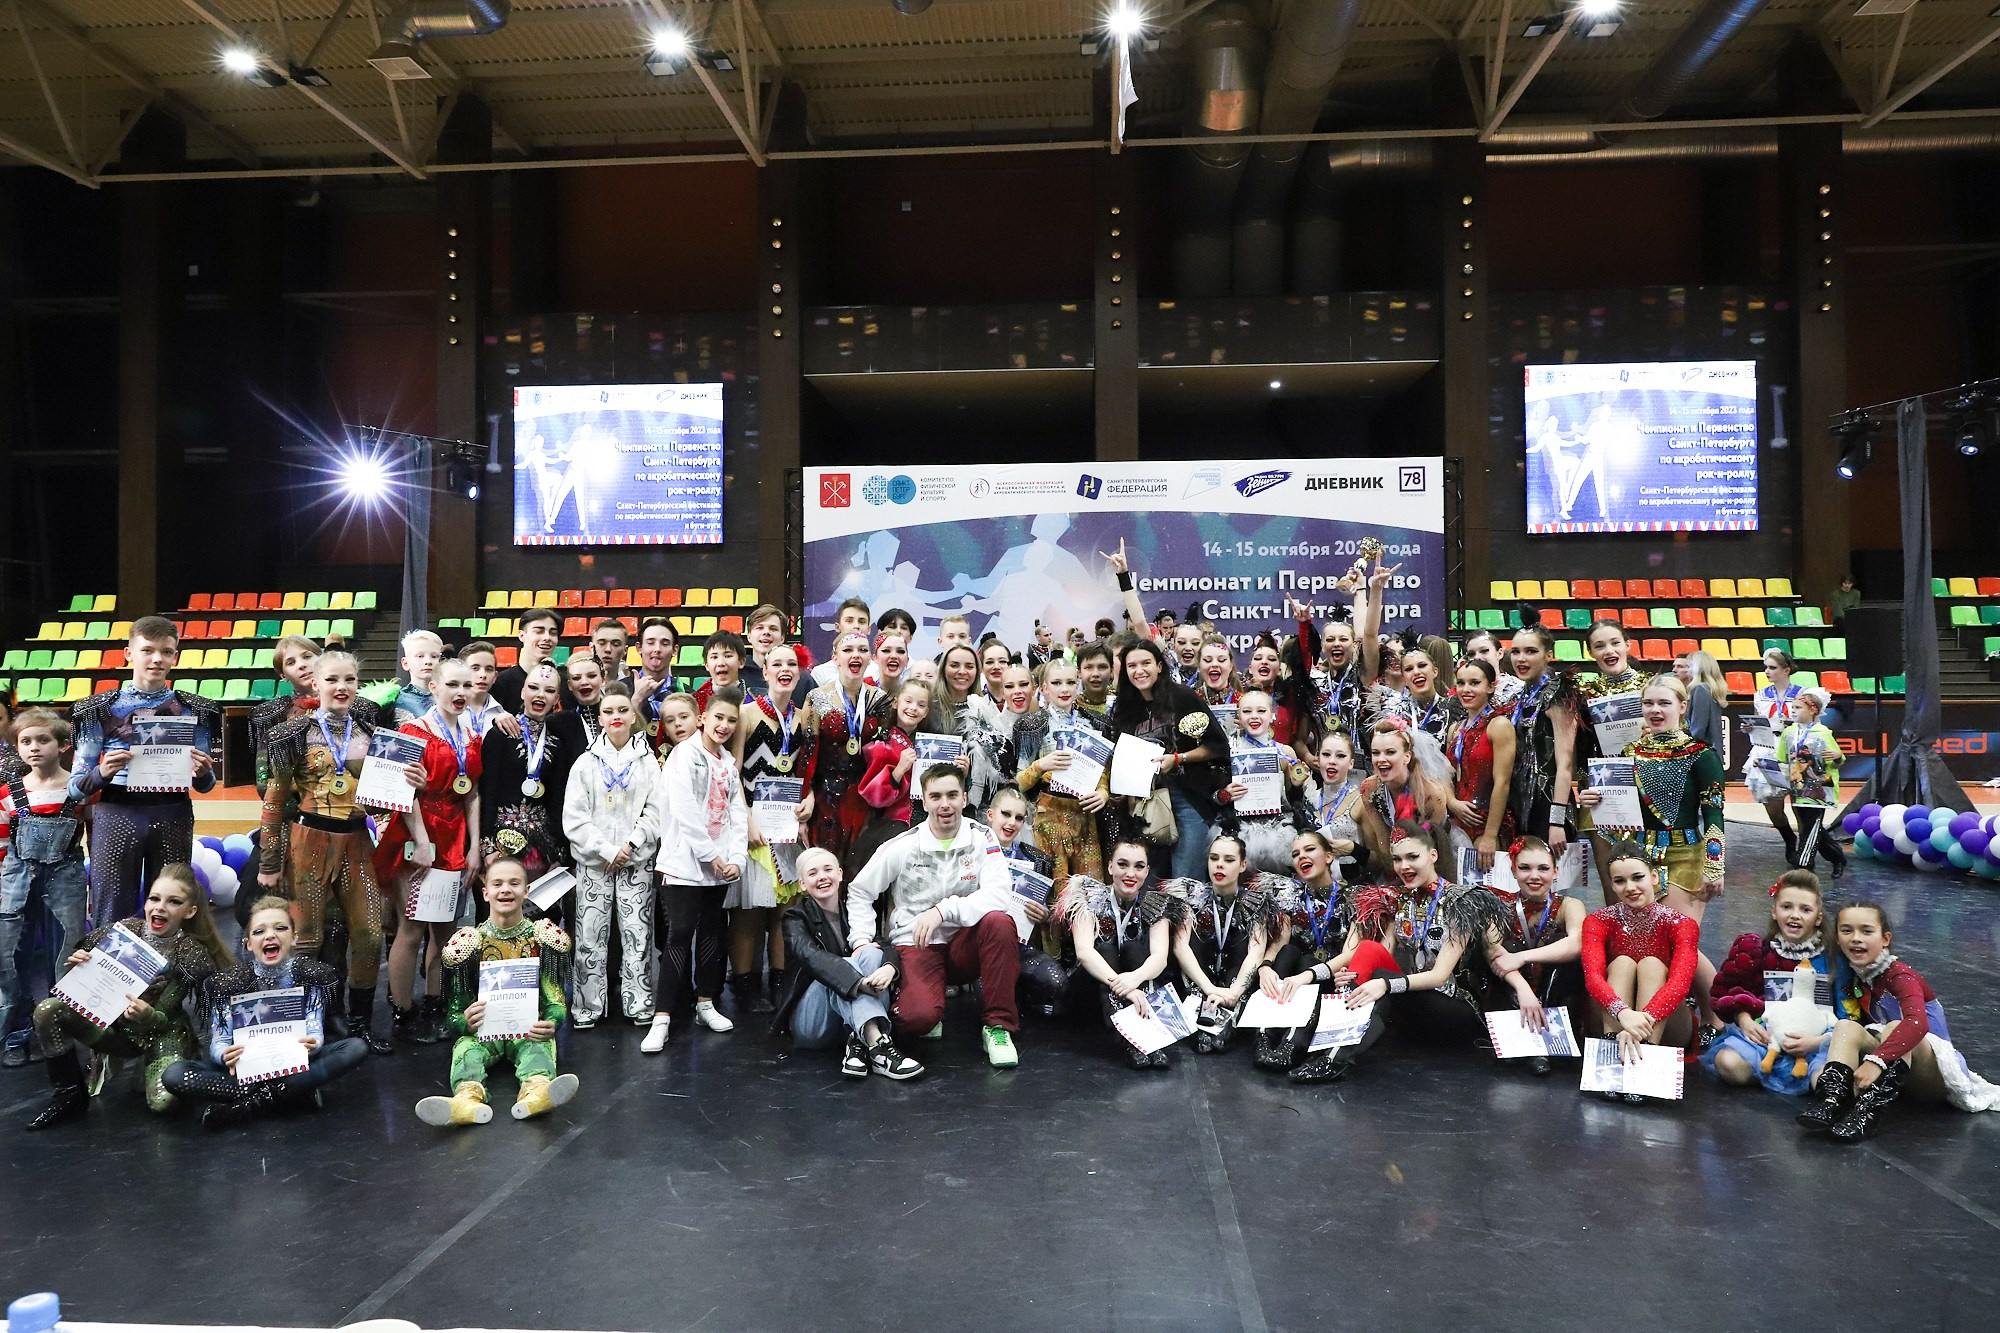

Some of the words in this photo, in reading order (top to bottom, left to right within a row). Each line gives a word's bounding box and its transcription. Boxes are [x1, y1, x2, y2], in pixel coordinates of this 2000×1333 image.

[1720, 405, 1737, 415] 2023
[1738, 407, 1754, 415] года
[690, 425, 705, 434] 2023
[1698, 421, 1755, 435] Первенство
[670, 440, 721, 453] Первенство
[1668, 436, 1755, 450] Санкт-Петербурга
[643, 454, 721, 468] Санкт-Петербурга
[1659, 455, 1672, 464] по
[1673, 452, 1755, 467] акробатическому
[634, 472, 646, 481] по
[646, 470, 721, 483] акробатическому
[1304, 476, 1384, 491] ДНЕВНИК
[1403, 471, 1421, 487] 78
[1106, 484, 1168, 494] ФЕДЕРАЦИЯ
[1203, 543, 1222, 557] 14
[1236, 542, 1254, 557] 15
[1257, 542, 1330, 560] октября
[1257, 575, 1271, 591] и
[1605, 720, 1639, 731] ДИПЛОМ
[143, 748, 182, 756] ДИПЛОМ
[1241, 776, 1271, 784] ДИПЛОМ
[762, 803, 792, 811] ДИПЛОМ
[448, 881, 459, 913] ДИПЛОМ
[96, 958, 136, 987] ДИПЛОМ
[489, 992, 527, 1002] ДИПЛОМ
[248, 1025, 292, 1039] ДИПЛОМ
